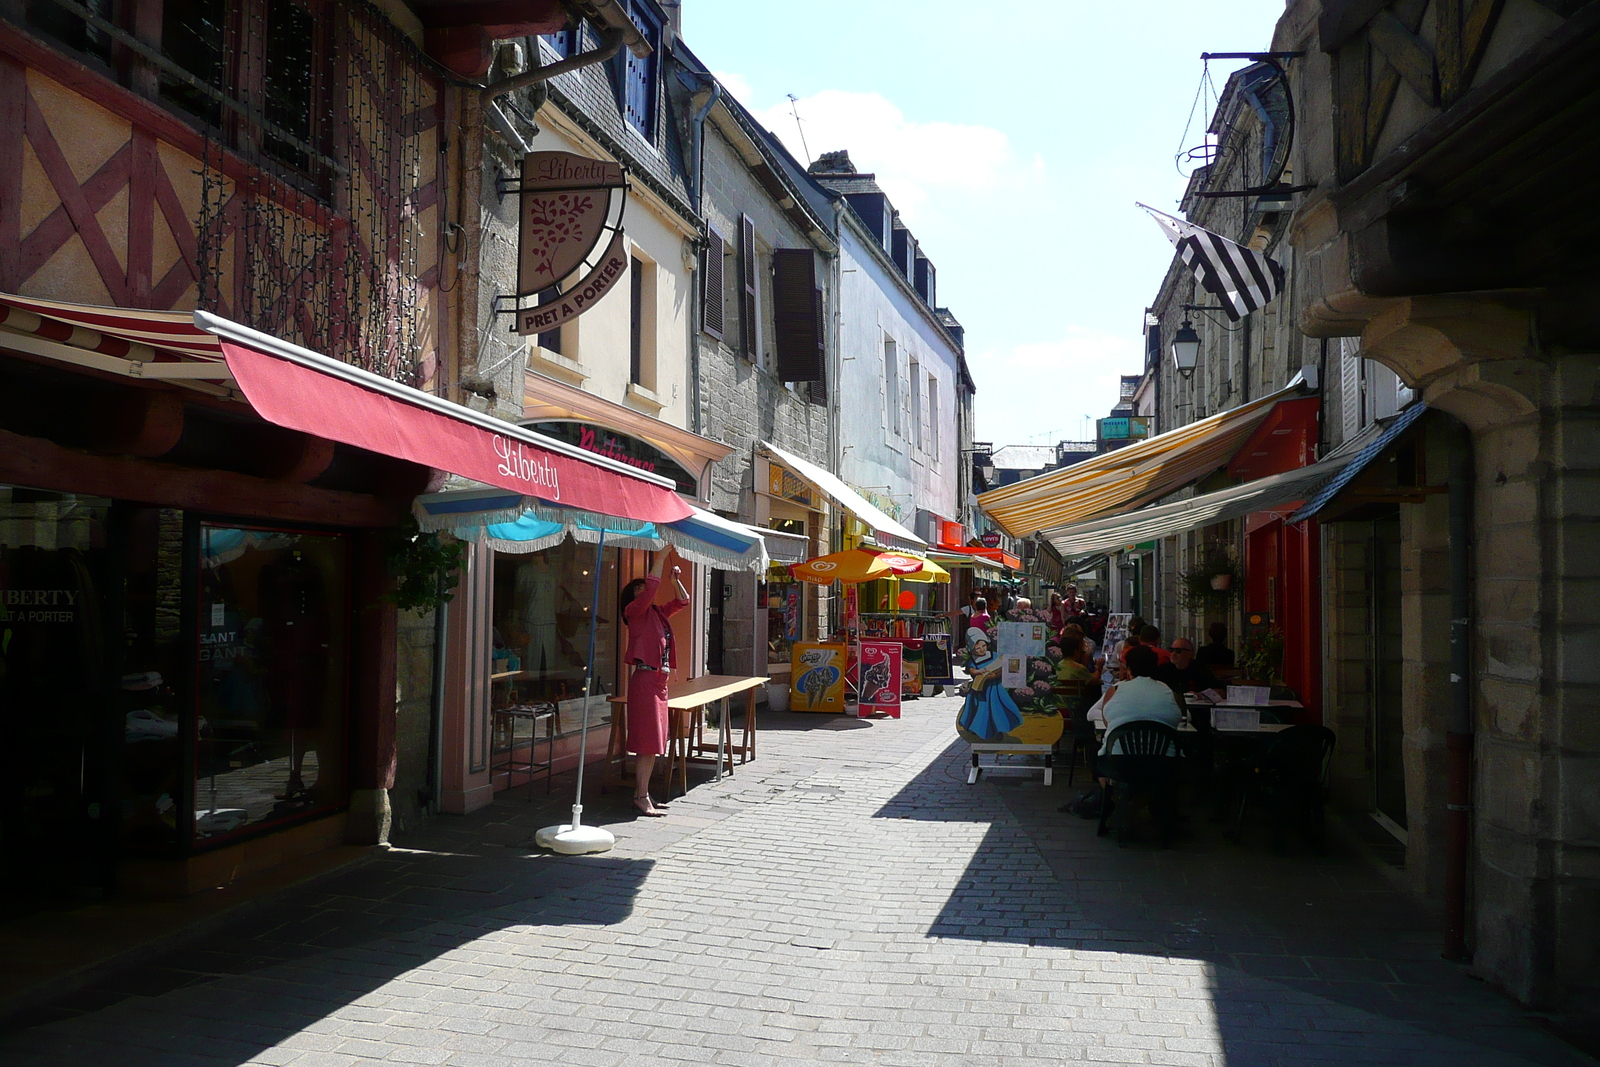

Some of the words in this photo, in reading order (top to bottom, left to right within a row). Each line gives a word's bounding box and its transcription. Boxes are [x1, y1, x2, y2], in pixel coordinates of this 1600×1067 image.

[538, 157, 607, 184] Liberty
[525, 308, 559, 330] PRET
[561, 303, 574, 318] A
[573, 257, 624, 308] PORTER
[493, 434, 560, 501] Liberty
[18, 611, 26, 621] A
[28, 611, 74, 622] PORTER
[200, 631, 236, 645] GANT
[199, 646, 248, 661] GANT
